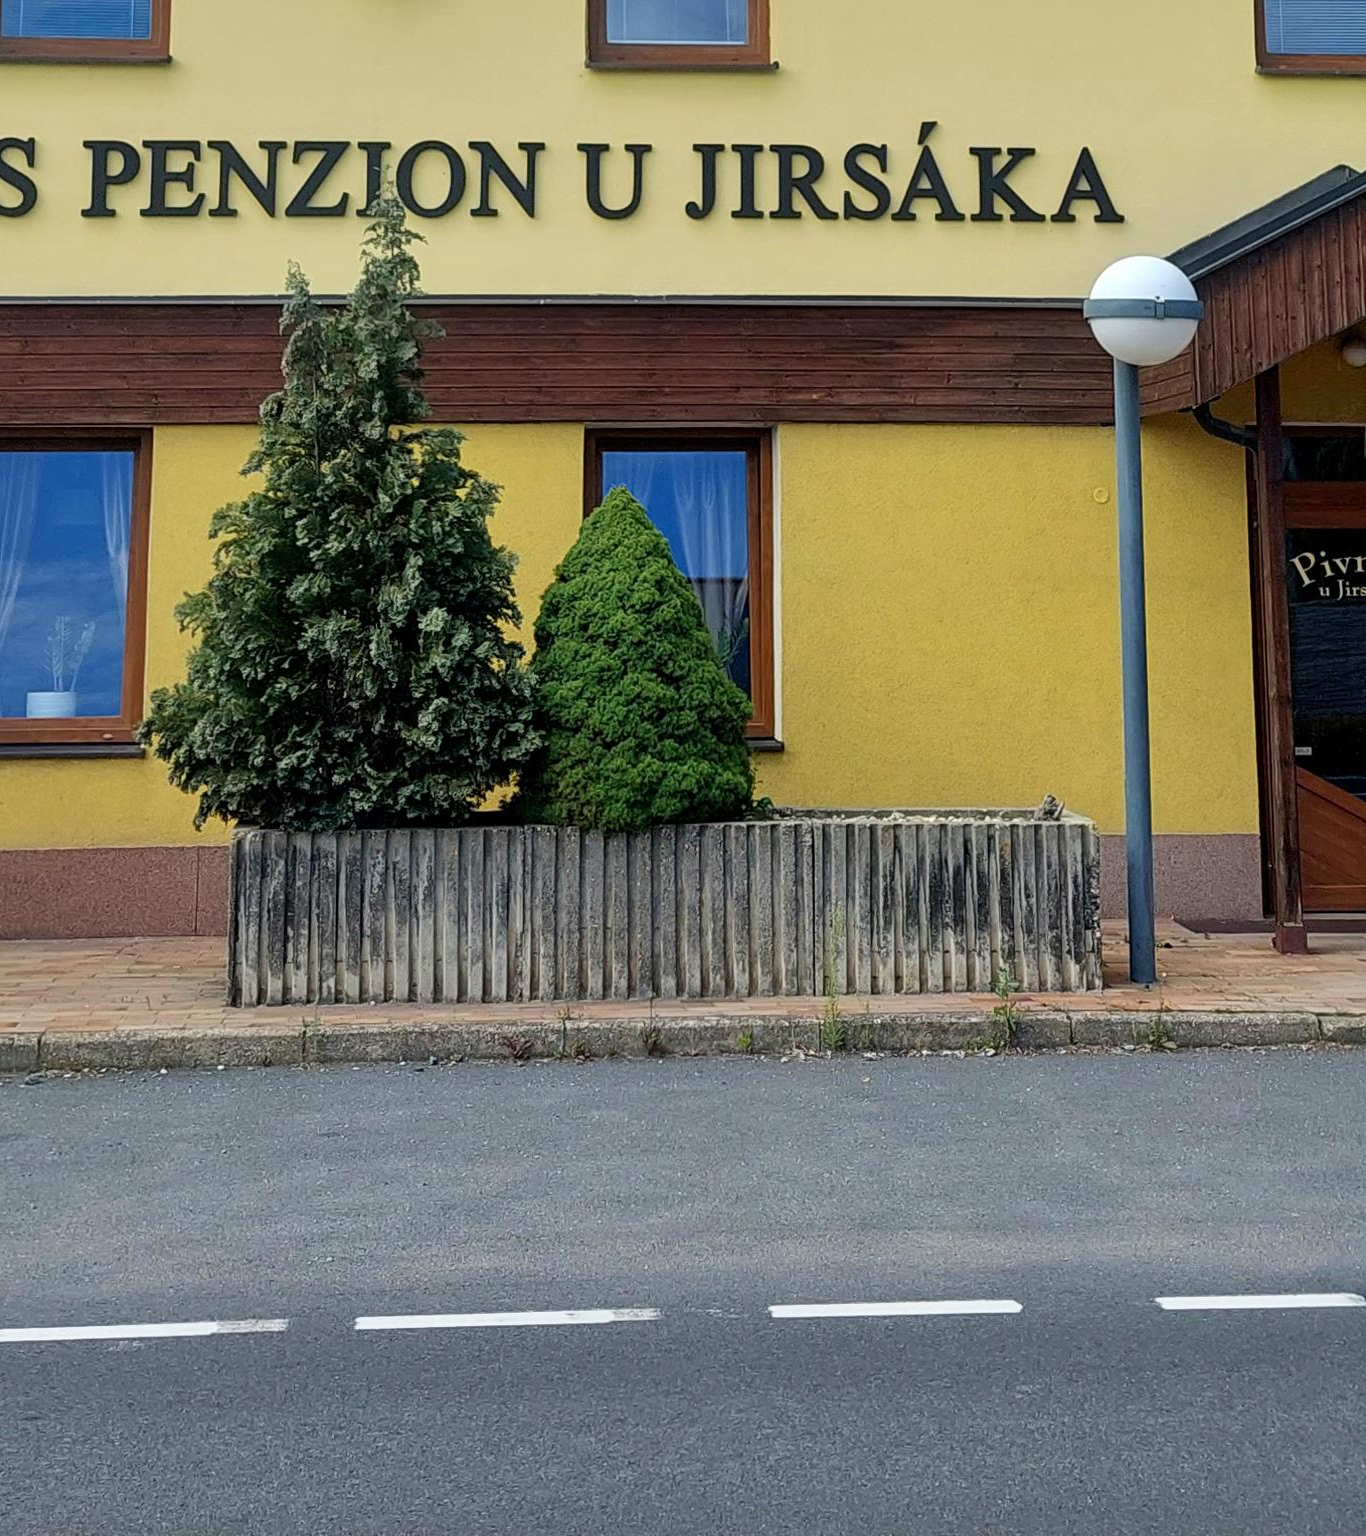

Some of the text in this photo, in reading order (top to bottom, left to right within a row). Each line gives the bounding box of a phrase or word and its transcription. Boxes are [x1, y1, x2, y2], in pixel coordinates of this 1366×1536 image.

[80, 138, 545, 219] PENZION
[576, 143, 653, 220] U
[685, 121, 1126, 223] JIRSÁKA
[1319, 586, 1330, 596] u
